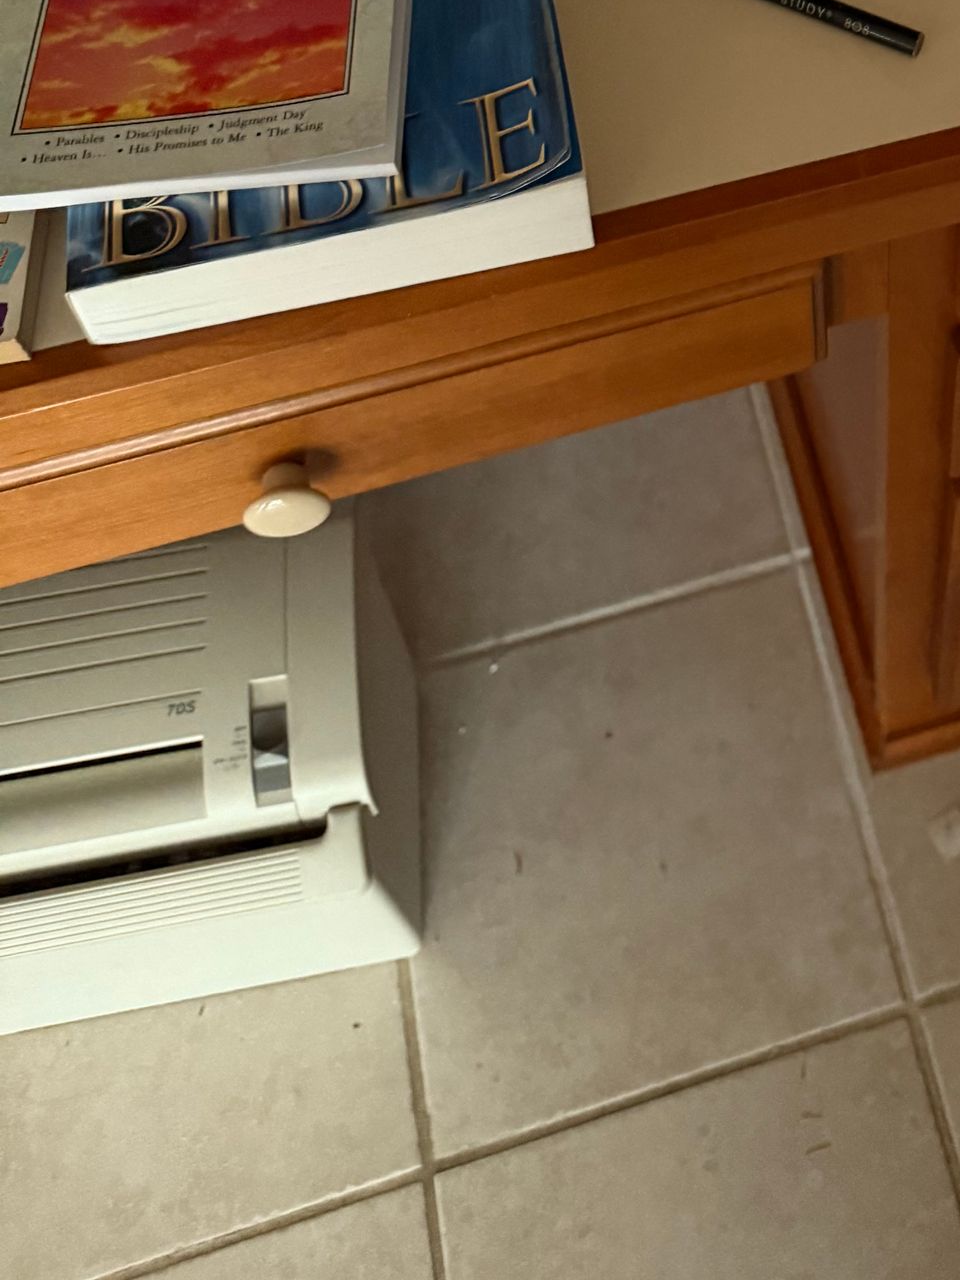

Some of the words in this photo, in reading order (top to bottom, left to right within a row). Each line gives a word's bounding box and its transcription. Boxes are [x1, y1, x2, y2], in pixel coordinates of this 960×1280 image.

[32, 152, 77, 164] Heaven
[128, 142, 150, 154] His
[154, 137, 208, 153] Promises
[211, 137, 224, 146] to
[227, 132, 247, 144] Me
[267, 127, 290, 138] The
[295, 121, 324, 133] King
[56, 134, 105, 147] Parables
[126, 124, 199, 140] Discipleship
[217, 114, 278, 132] Judgment
[283, 109, 307, 121] Day
